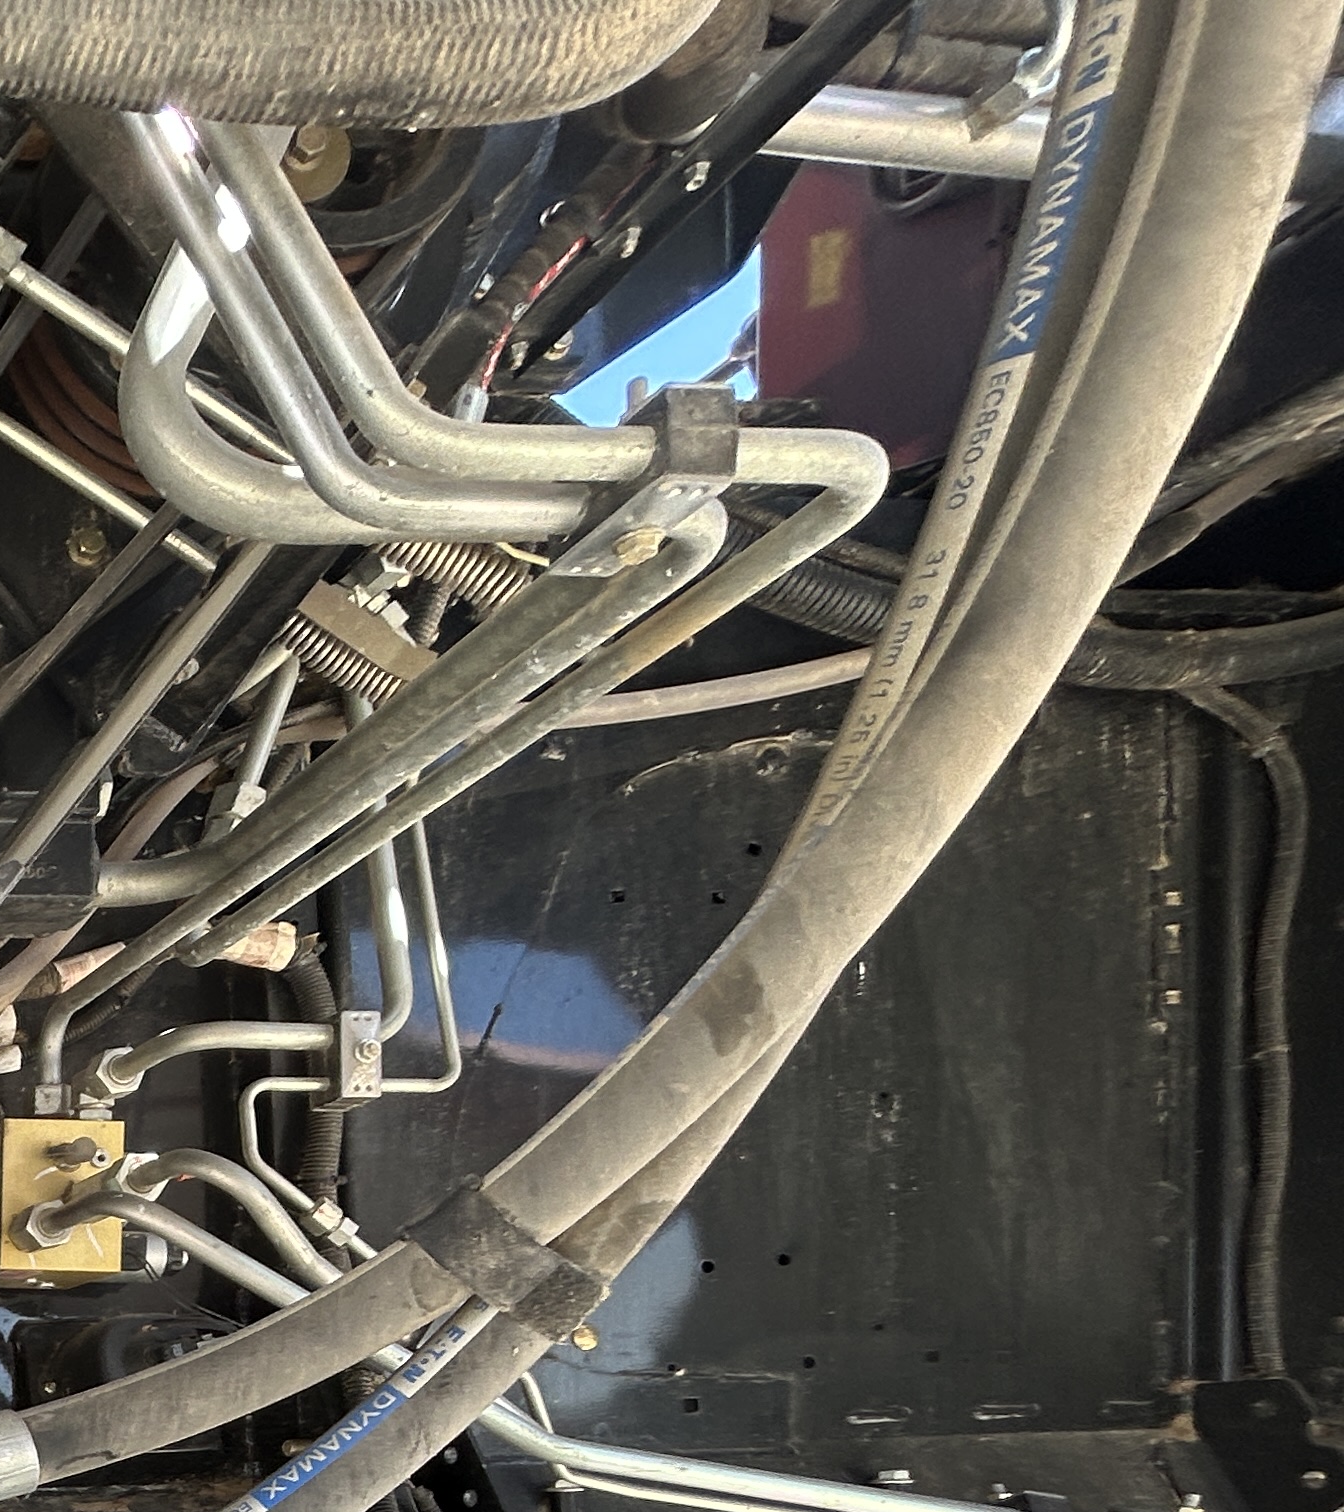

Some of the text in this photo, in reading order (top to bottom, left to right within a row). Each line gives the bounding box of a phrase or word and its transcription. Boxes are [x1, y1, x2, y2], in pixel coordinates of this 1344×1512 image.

[997, 109, 1097, 350] DYNAMAX
[880, 620, 914, 668] mm
[261, 1390, 397, 1501] DYNAMAX
